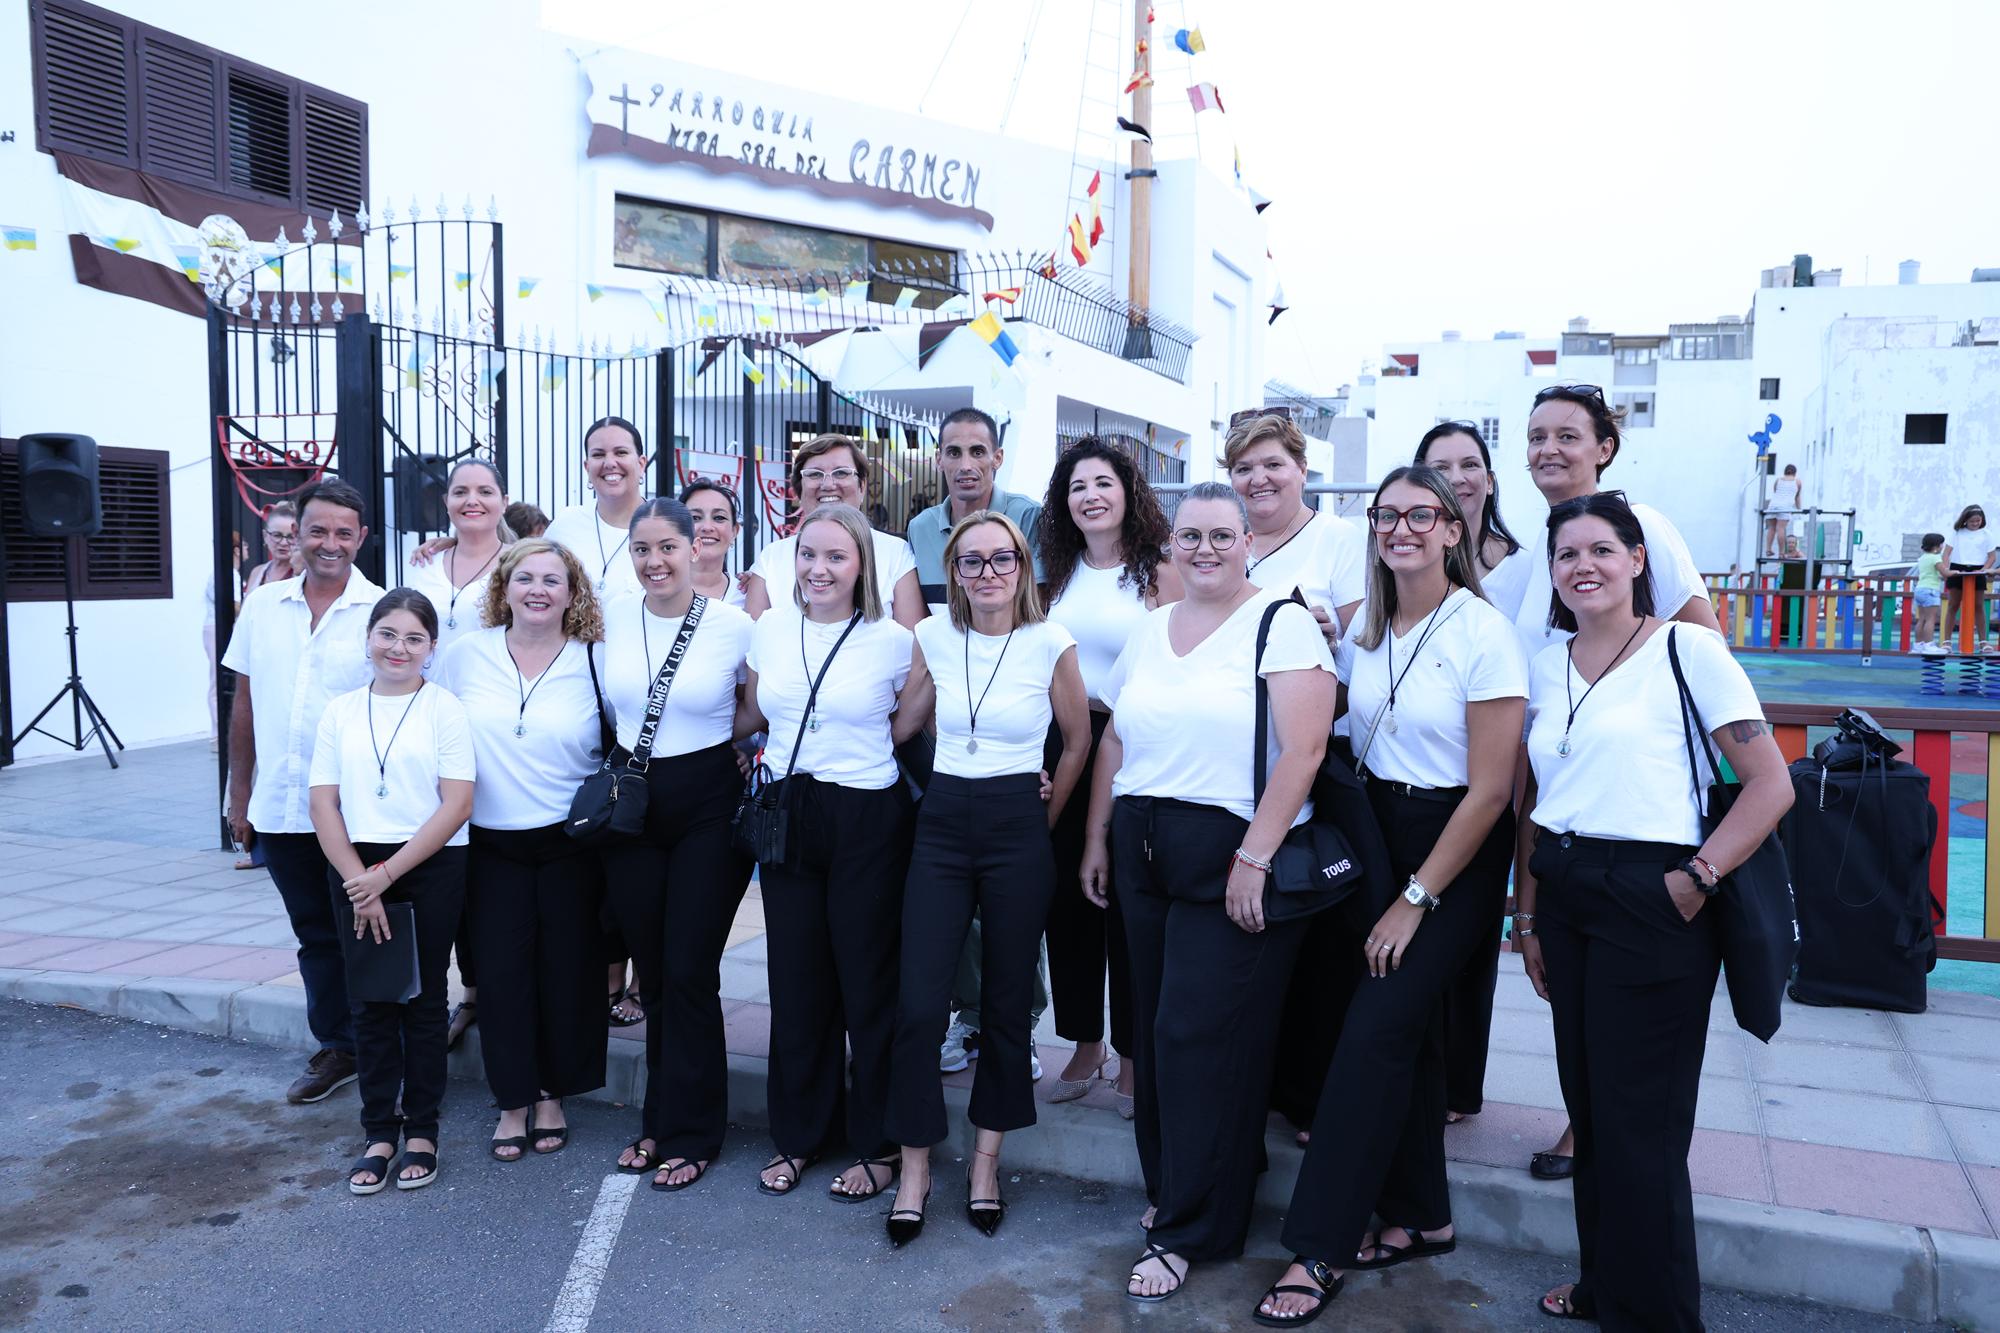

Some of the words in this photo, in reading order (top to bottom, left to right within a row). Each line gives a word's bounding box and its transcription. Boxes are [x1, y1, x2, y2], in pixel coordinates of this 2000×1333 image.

[649, 83, 814, 143] PARROQUIA
[795, 151, 828, 181] DEL
[849, 138, 981, 209] CARMEN
[668, 630, 693, 663] LOLA
[663, 663, 675, 673] Y
[648, 676, 672, 717] BIMBA
[638, 720, 658, 750] OLA
[1322, 858, 1352, 879] TOUS
